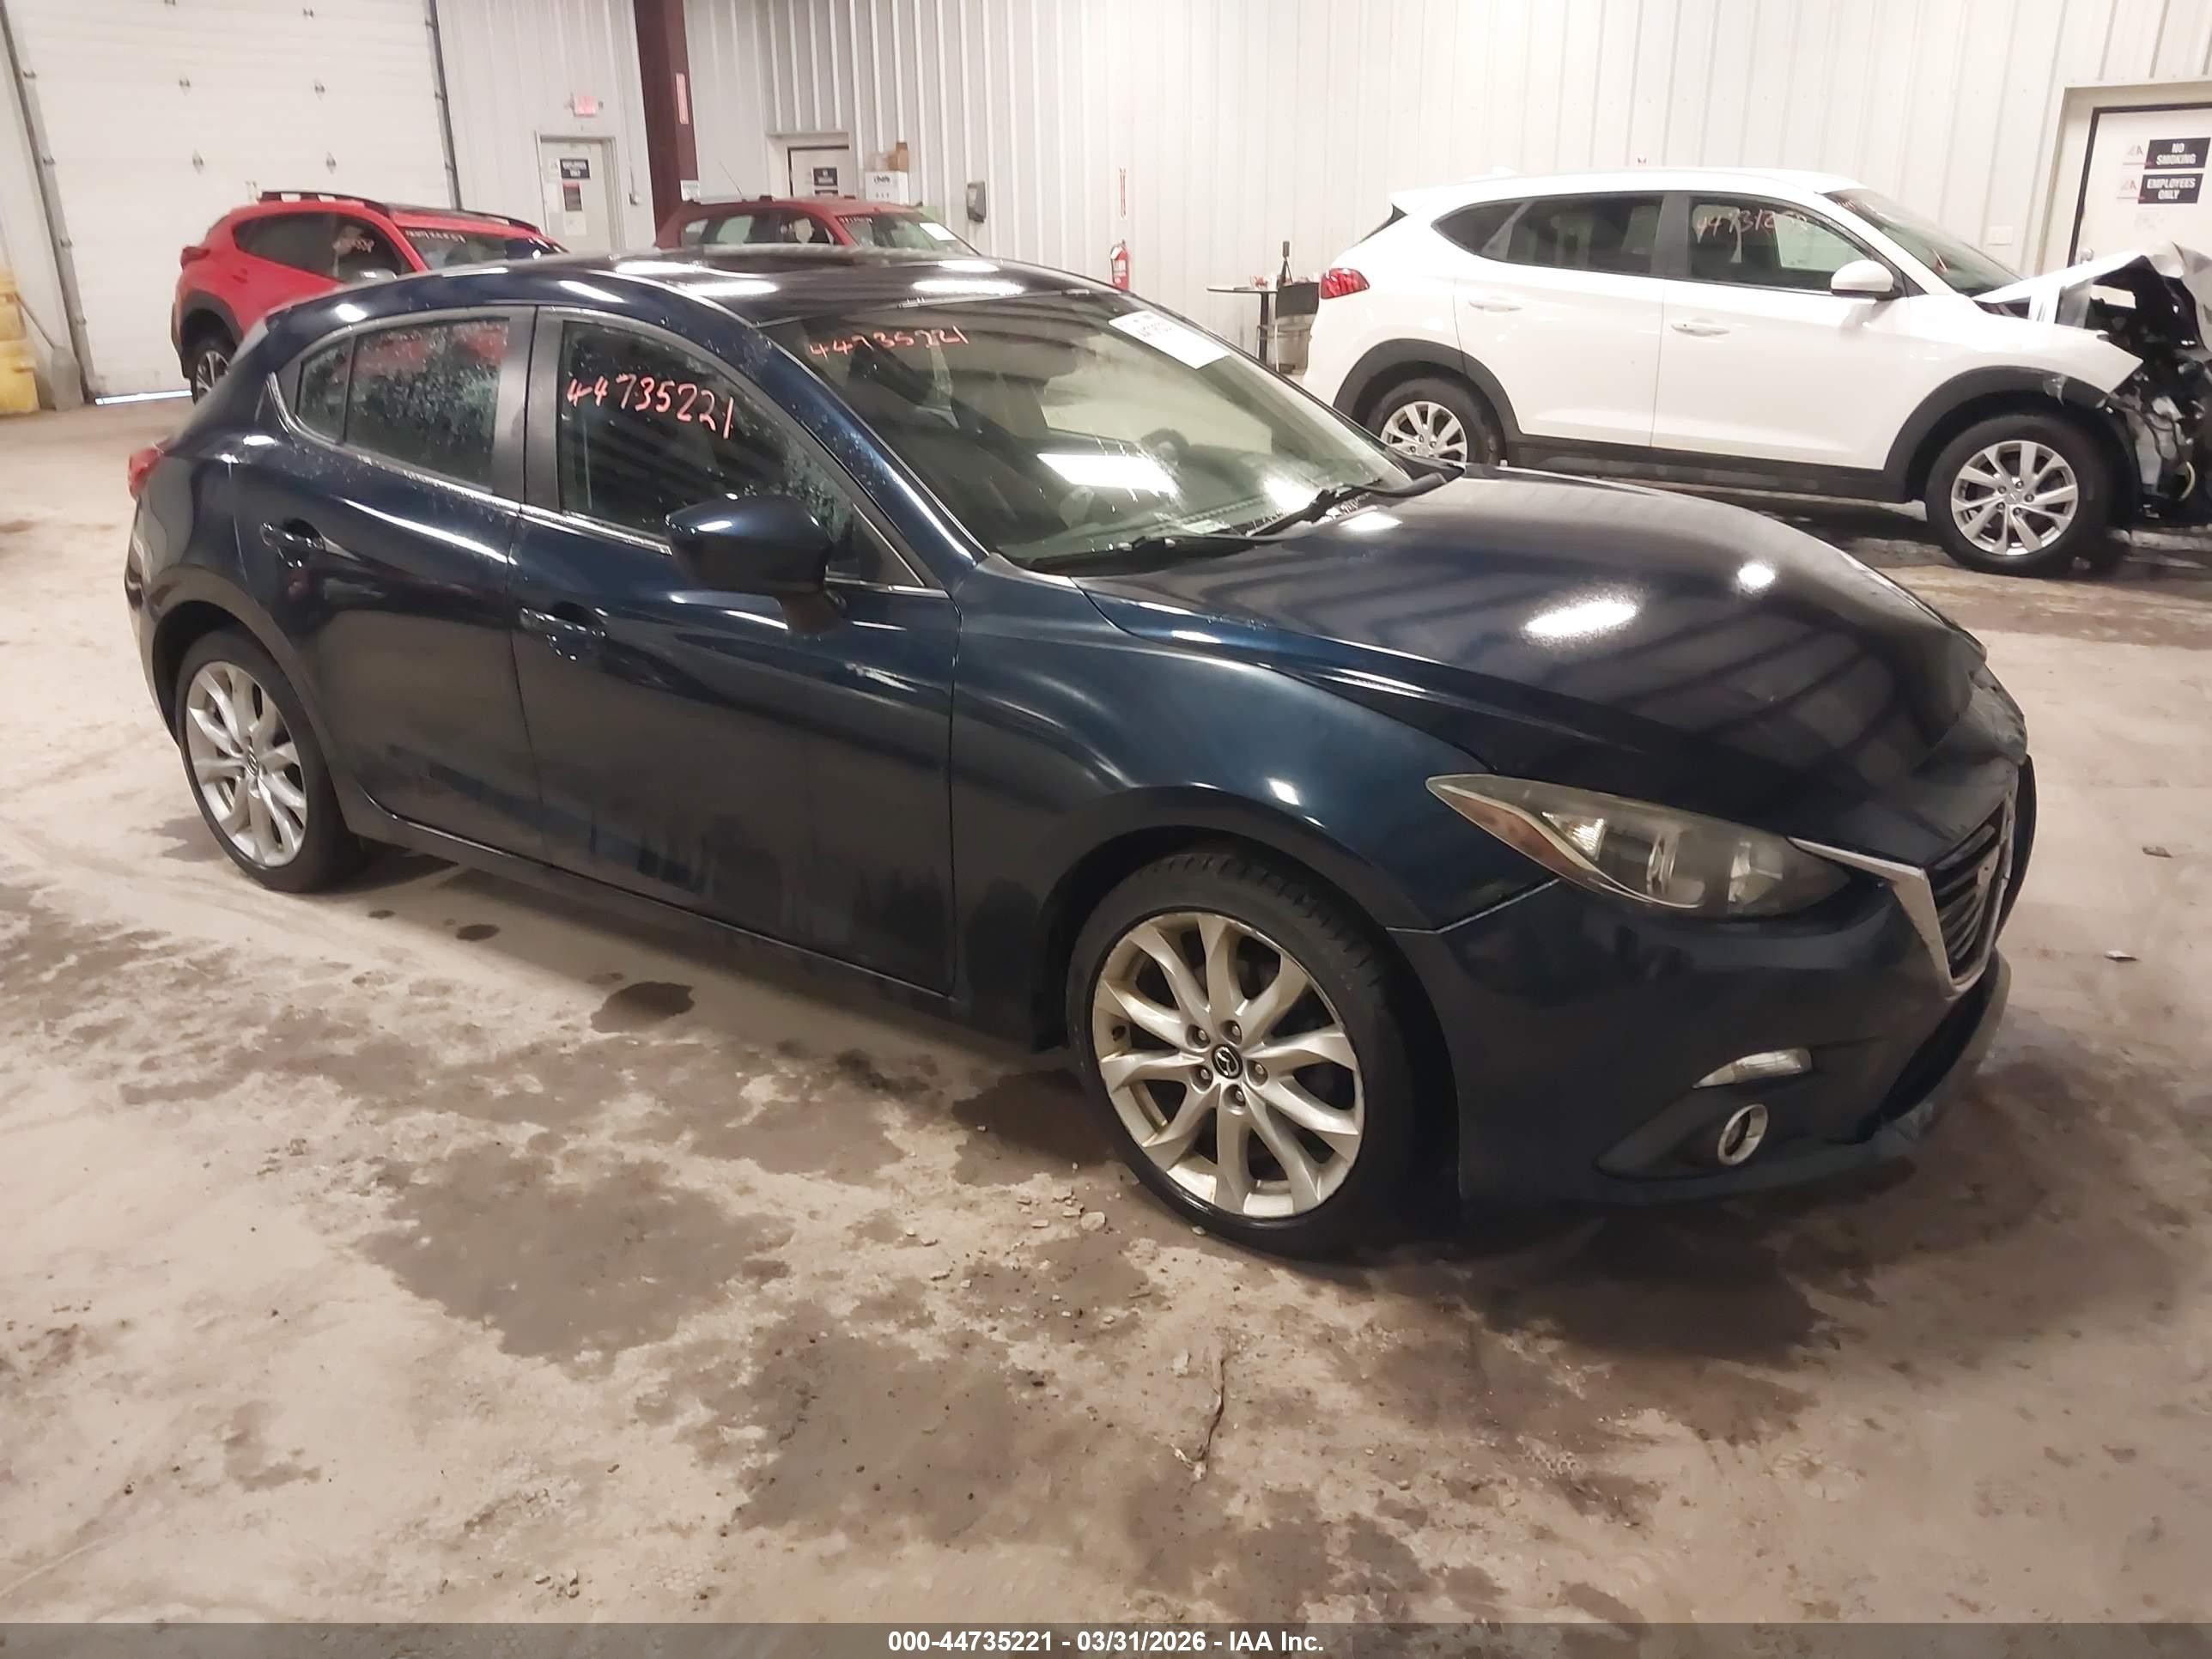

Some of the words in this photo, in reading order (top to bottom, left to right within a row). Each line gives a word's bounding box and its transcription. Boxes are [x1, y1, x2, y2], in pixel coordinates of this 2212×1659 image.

[2172, 143, 2185, 154] NO
[2156, 154, 2196, 165] SMOKING
[2148, 178, 2196, 189] EMPLOYEES
[2158, 189, 2180, 199] ONLY
[810, 325, 969, 364] 44735221
[567, 374, 734, 440] 44735221
